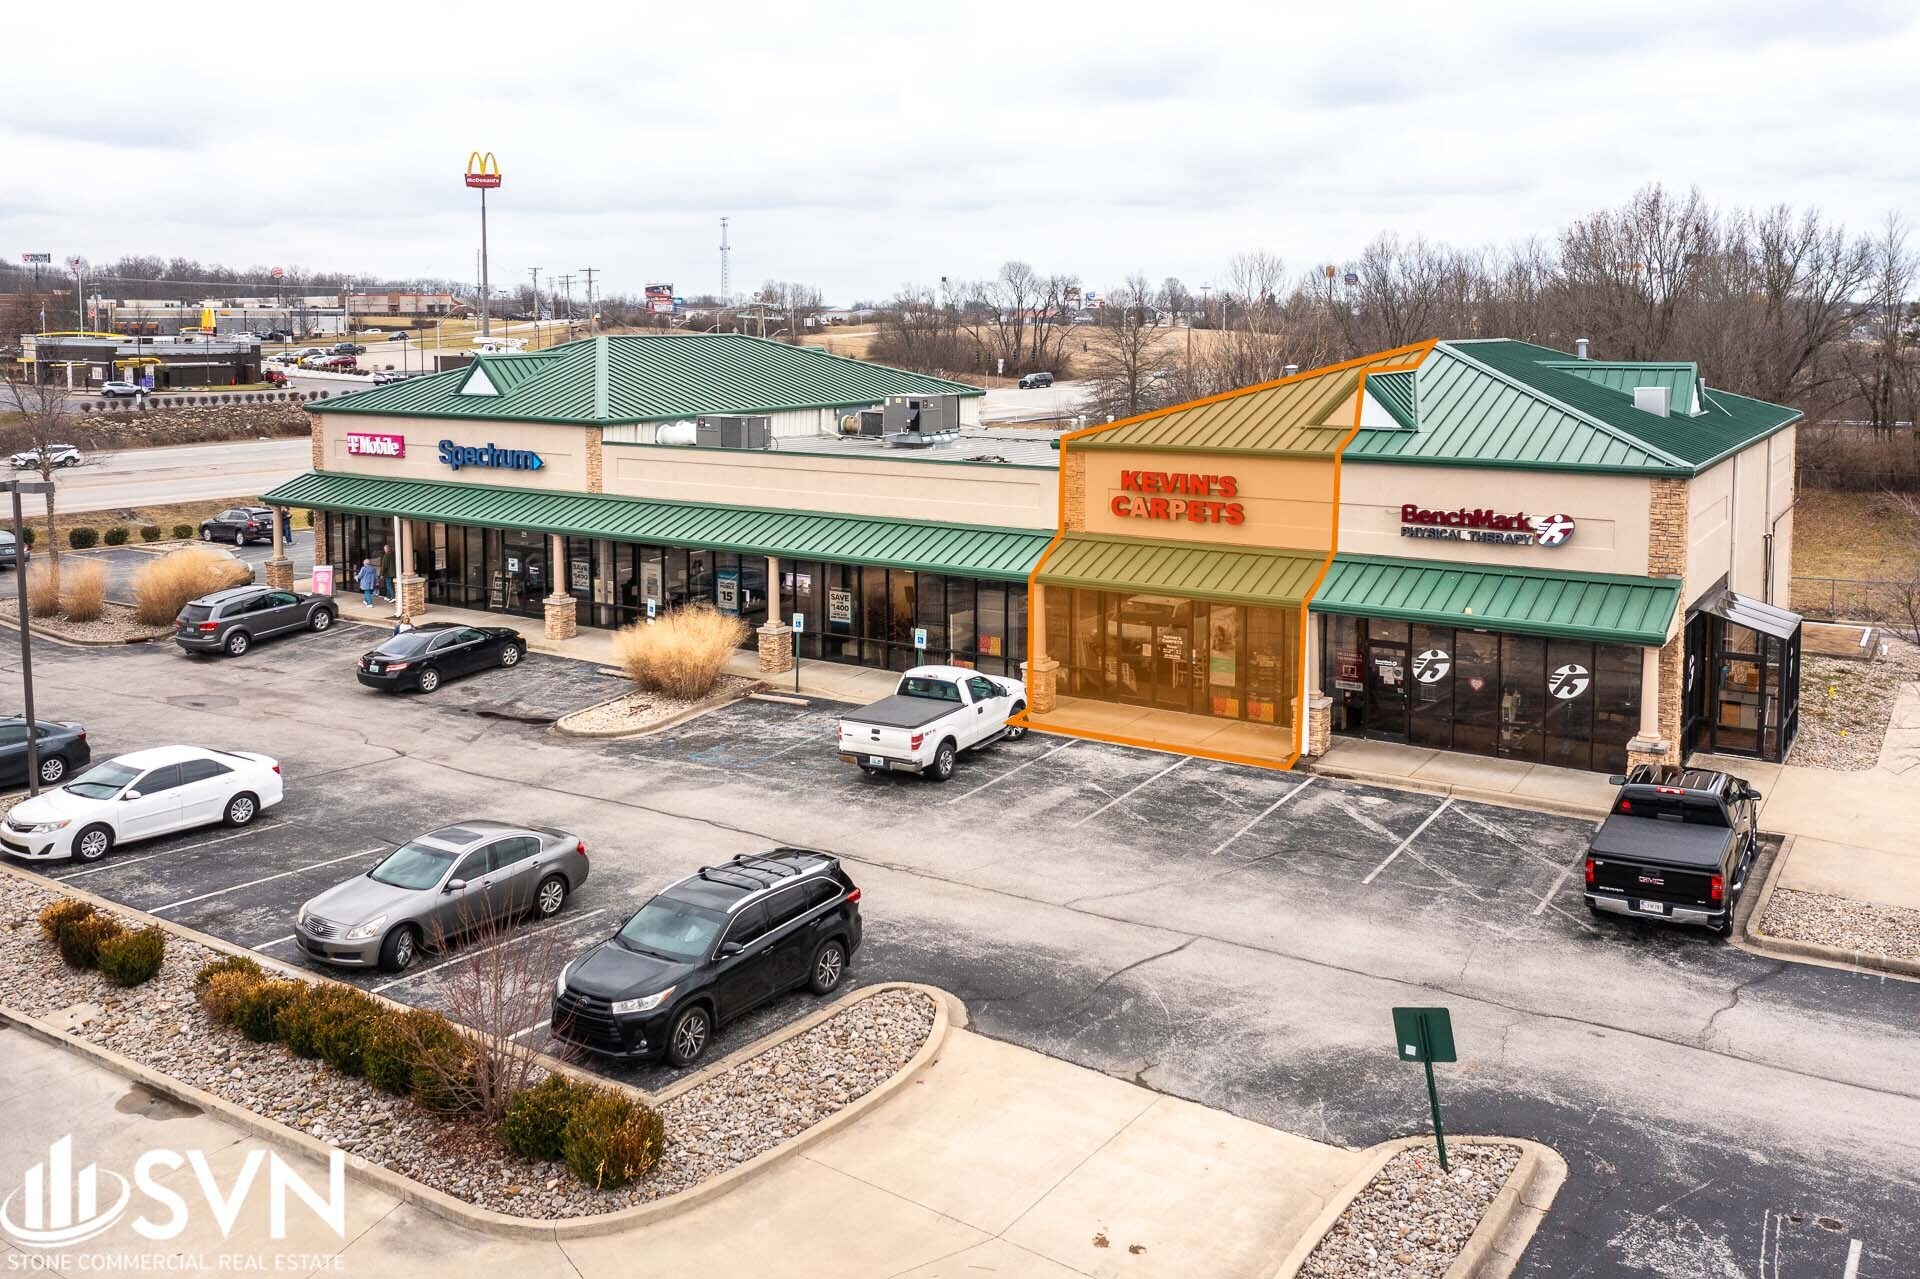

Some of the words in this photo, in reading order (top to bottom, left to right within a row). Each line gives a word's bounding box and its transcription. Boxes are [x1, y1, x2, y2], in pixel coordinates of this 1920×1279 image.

[438, 439, 535, 471] Spectrum
[1120, 470, 1238, 498] KEVIN'S
[1111, 495, 1245, 525] CARPETS
[1401, 503, 1535, 530] BenchMark
[1400, 526, 1464, 542] PHYSICAL
[1467, 530, 1533, 546] THERAPY
[830, 593, 850, 602] SAVE
